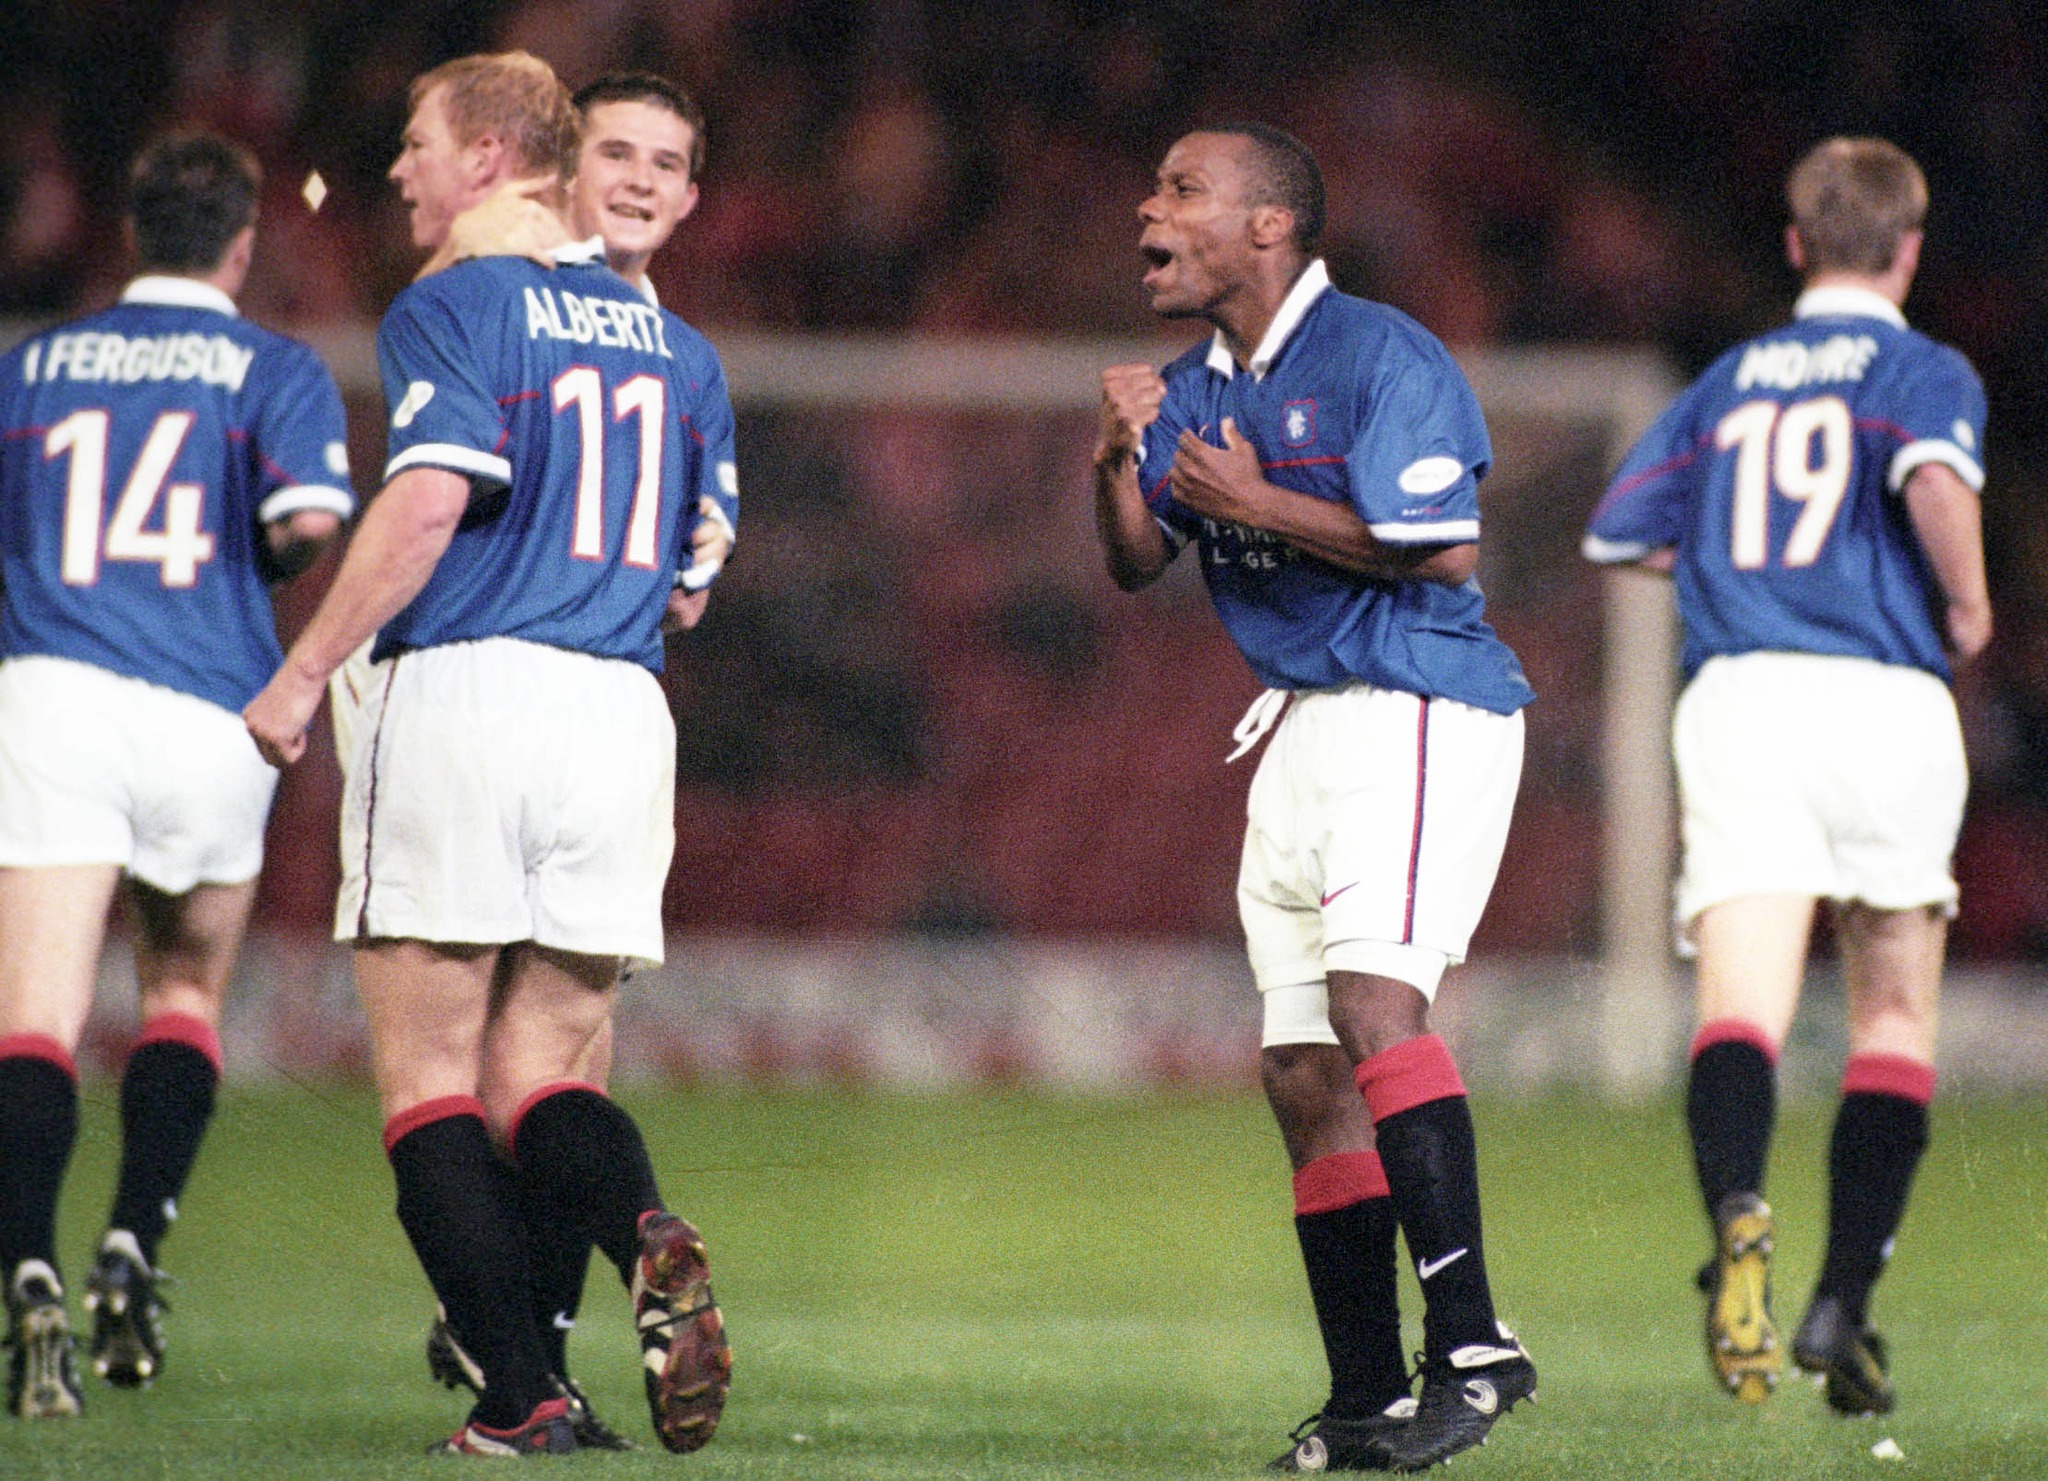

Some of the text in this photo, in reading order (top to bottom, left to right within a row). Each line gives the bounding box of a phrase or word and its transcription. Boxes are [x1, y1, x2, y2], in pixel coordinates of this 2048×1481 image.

[45, 331, 253, 392] FERGUSON
[44, 409, 215, 588] 14
[551, 364, 665, 570] 11
[1715, 395, 1852, 570] 19
